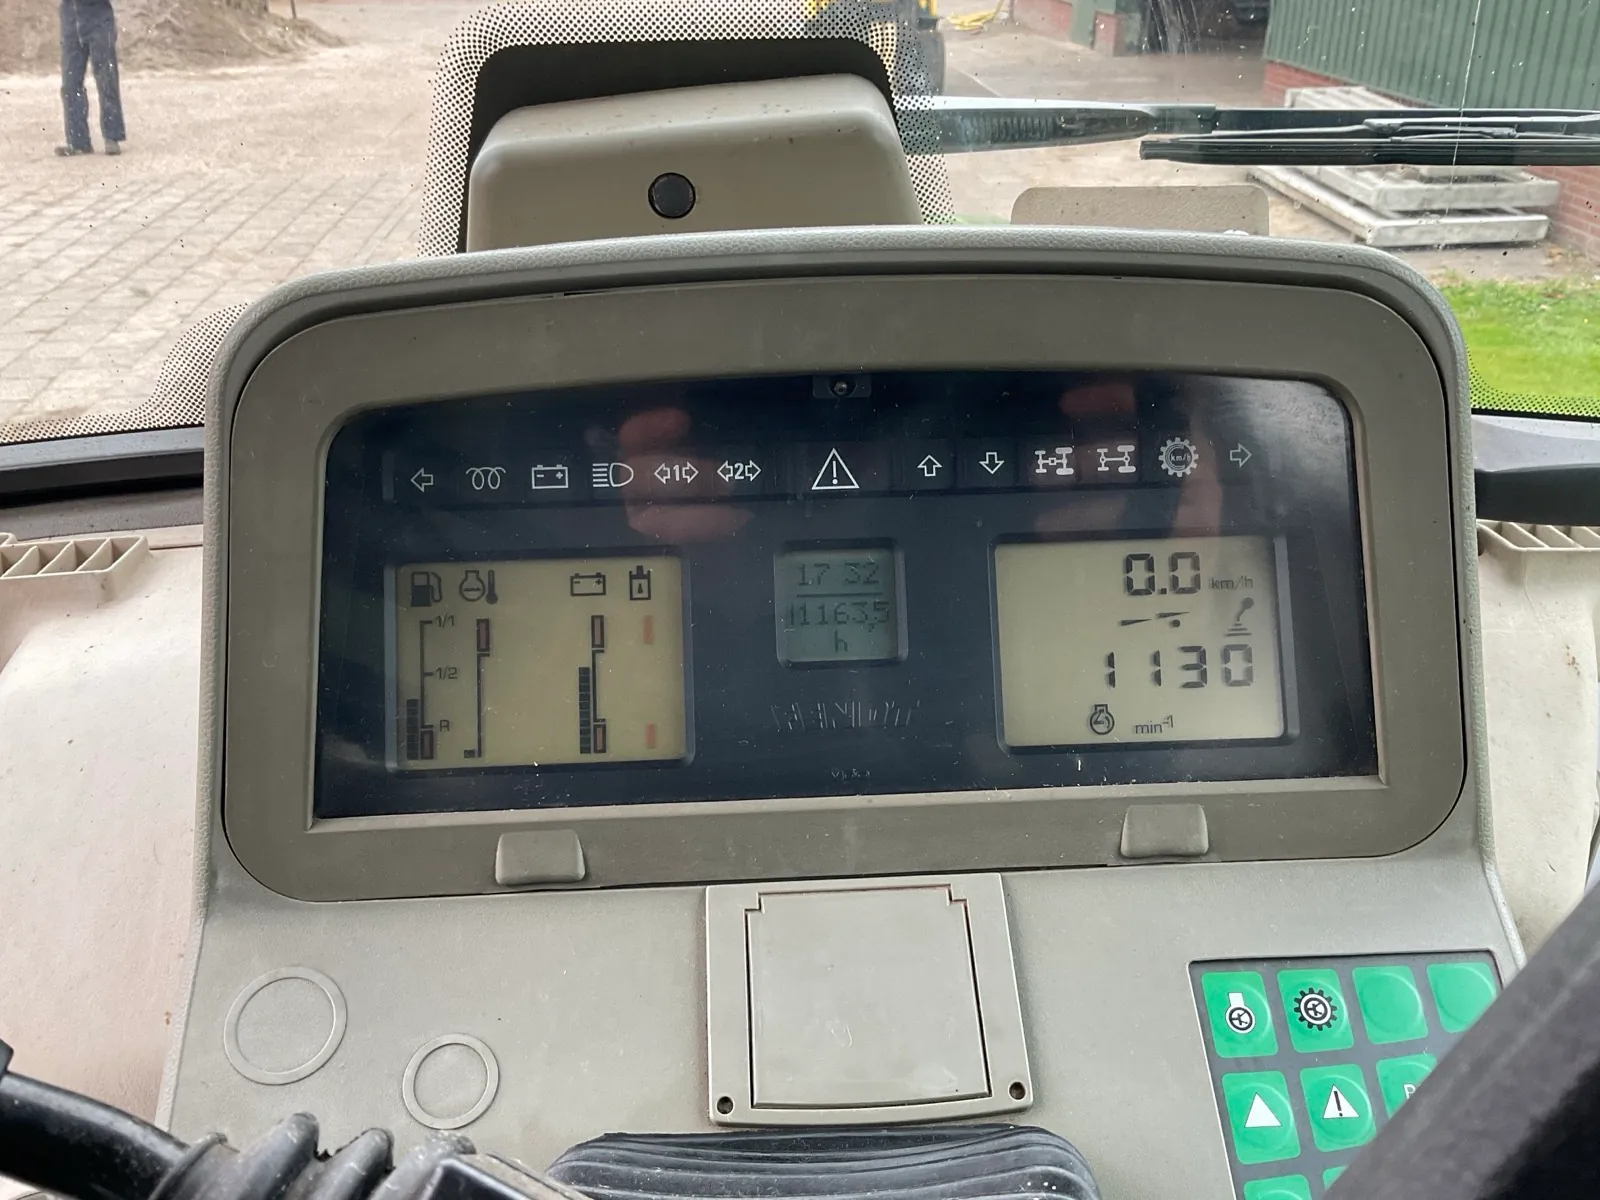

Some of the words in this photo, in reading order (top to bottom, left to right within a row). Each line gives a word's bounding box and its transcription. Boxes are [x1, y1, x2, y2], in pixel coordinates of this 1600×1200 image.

[673, 464, 680, 481] 1
[734, 463, 745, 480] 2
[1124, 551, 1201, 596] 0.0
[1209, 574, 1254, 590] km/h
[434, 614, 455, 627] 1/1
[834, 629, 848, 653] h
[435, 666, 458, 680] 1/2
[1105, 643, 1254, 689] 1130
[438, 719, 450, 733] R
[1403, 1083, 1416, 1100] P
